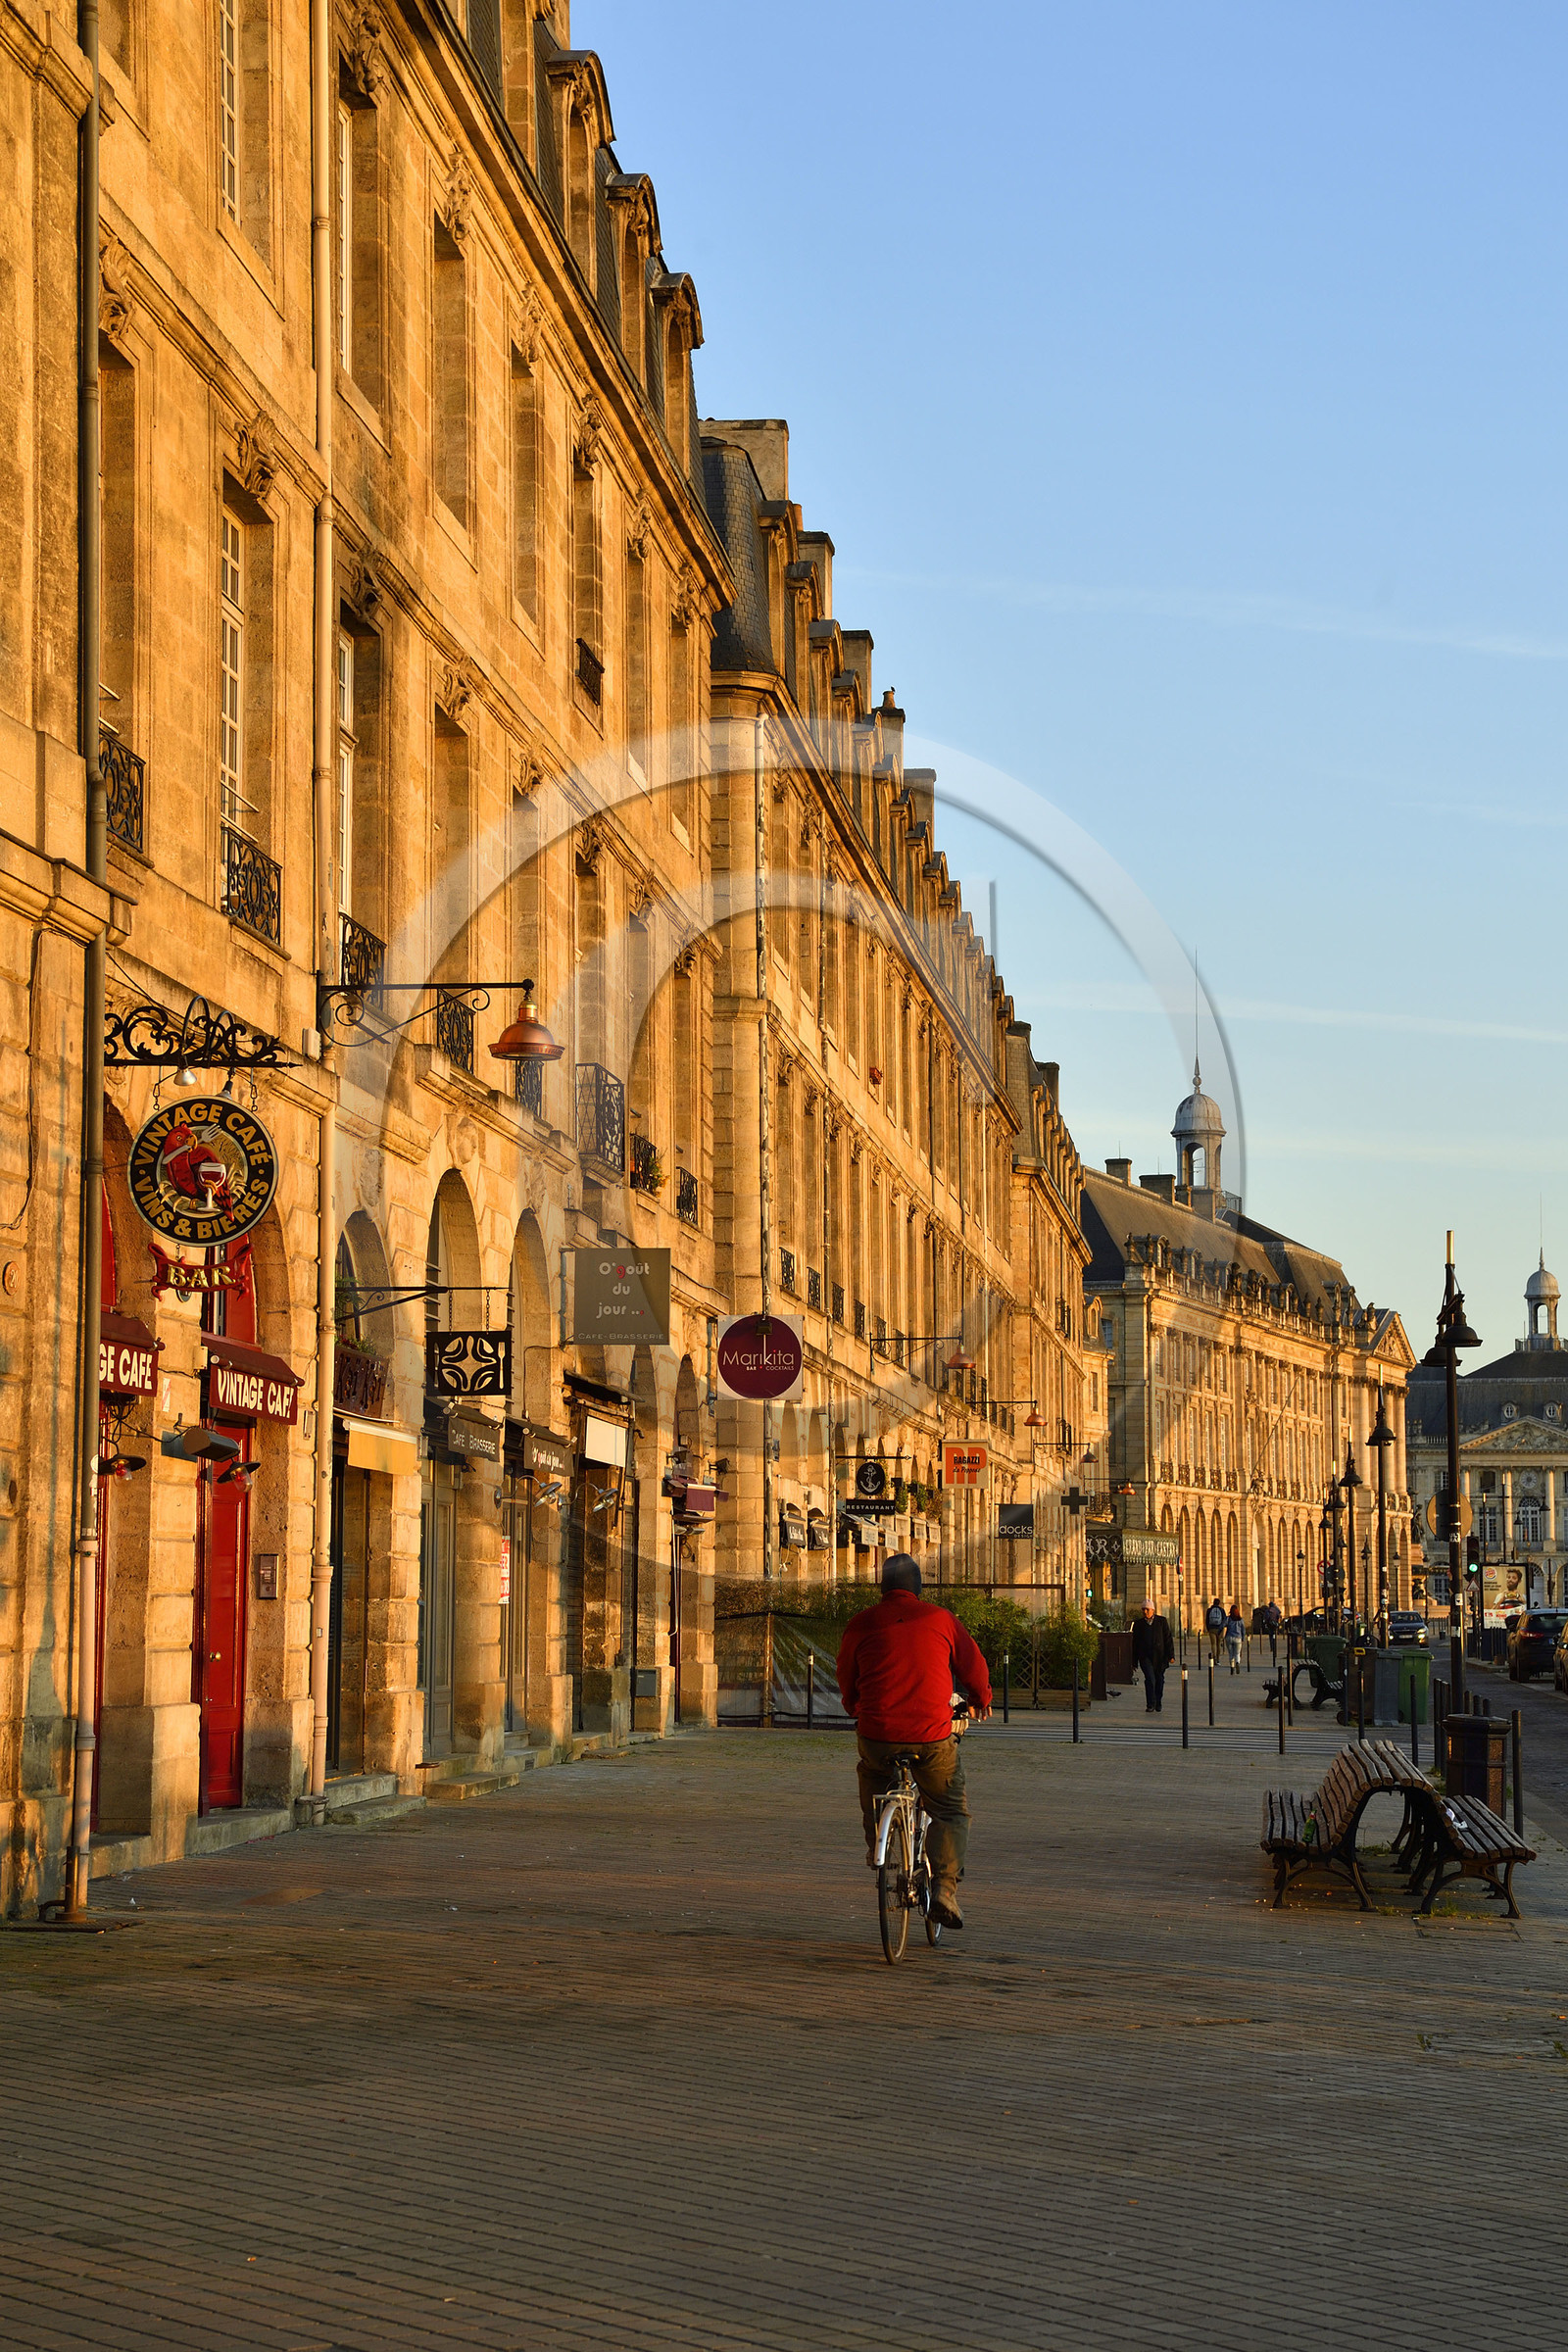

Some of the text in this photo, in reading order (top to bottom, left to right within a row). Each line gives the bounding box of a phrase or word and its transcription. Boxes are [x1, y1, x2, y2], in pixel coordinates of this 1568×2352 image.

[134, 1102, 273, 1166] VINTAGE CAFÉ
[134, 1175, 174, 1229] VINS
[173, 1218, 192, 1238] &
[167, 1263, 236, 1289] BAR
[612, 1282, 631, 1296] du
[722, 1336, 795, 1366] Marikita
[217, 1368, 264, 1411] VINTAGE
[954, 1456, 980, 1465] RAGAZZI
[999, 1525, 1033, 1535] docks
